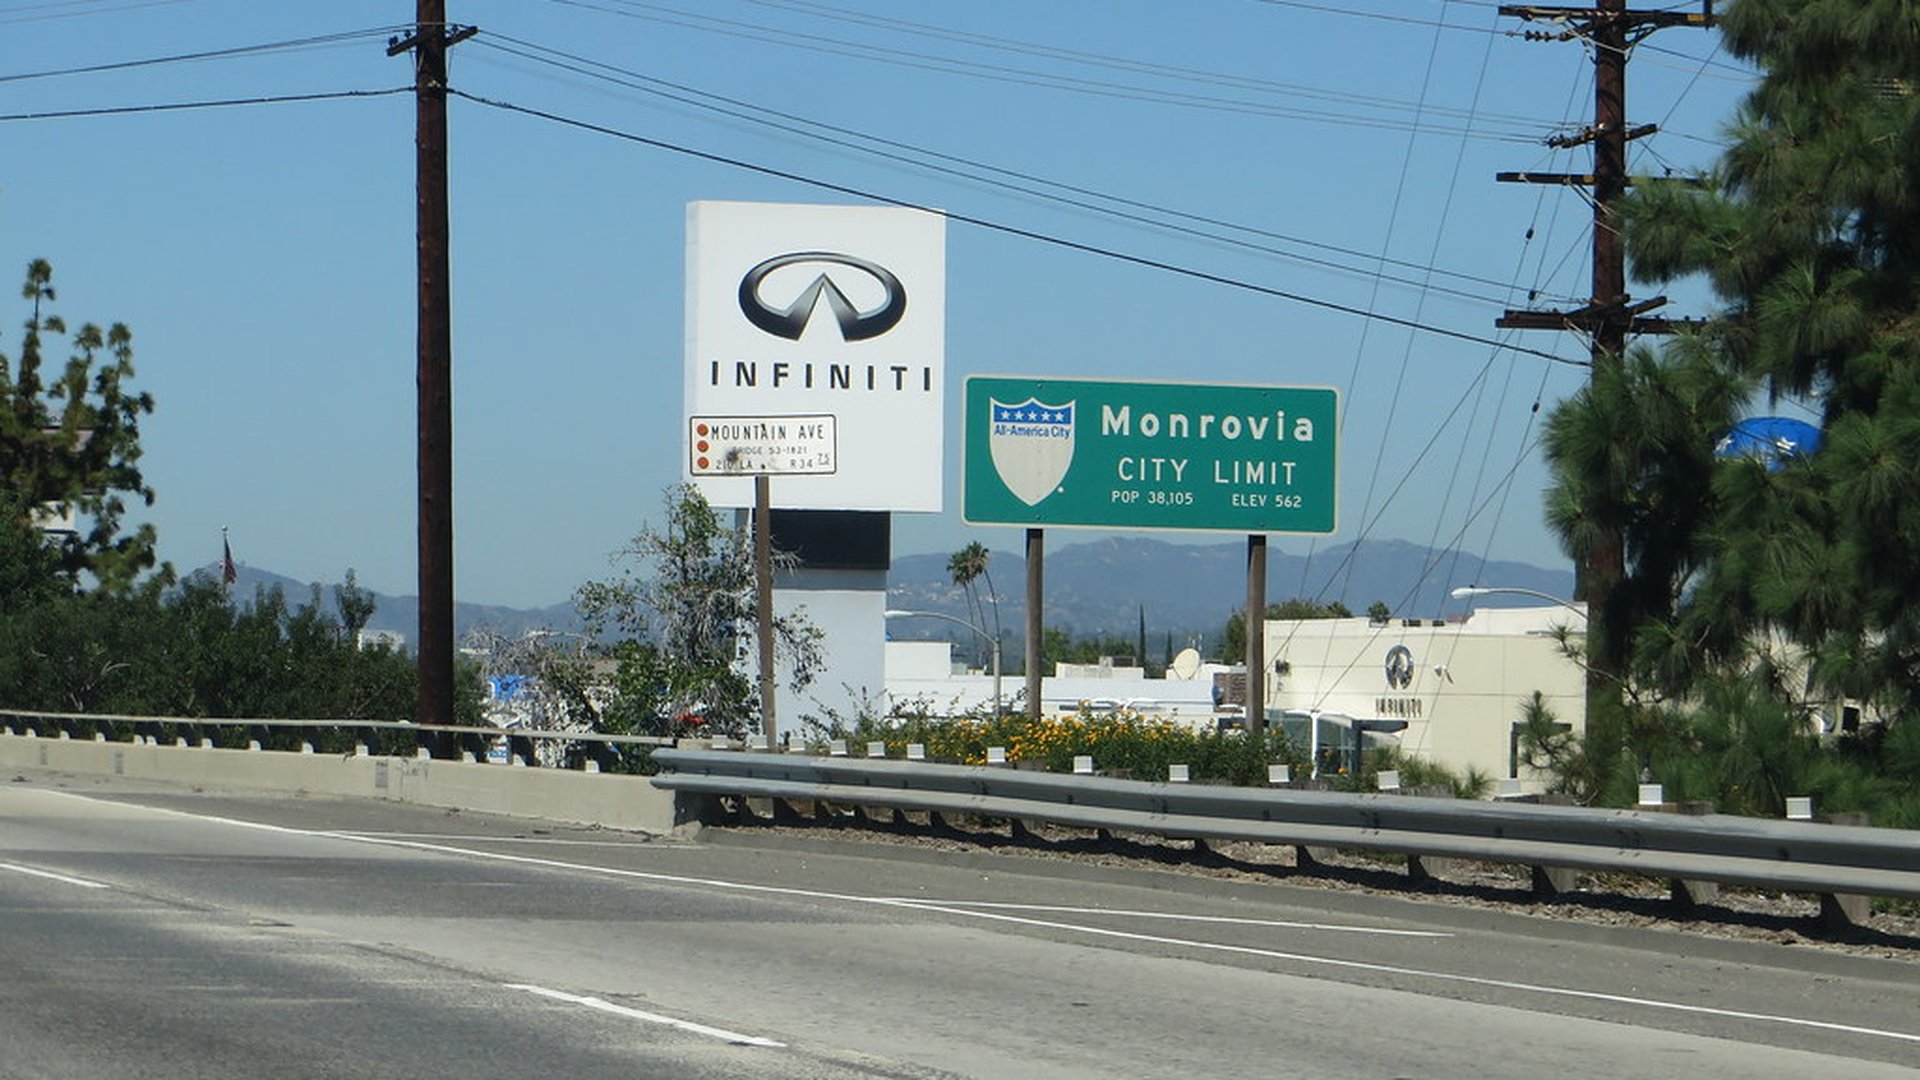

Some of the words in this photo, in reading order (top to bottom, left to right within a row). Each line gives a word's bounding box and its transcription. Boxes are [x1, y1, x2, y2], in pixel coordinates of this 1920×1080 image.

[711, 360, 931, 392] INFINITI
[711, 424, 787, 440] MOUNTAIN
[798, 424, 824, 440] AVE
[994, 424, 1049, 438] All-America
[1051, 426, 1071, 439] City
[1102, 404, 1314, 442] Monrovia
[1118, 457, 1188, 482] CITY
[1214, 460, 1296, 485] LIMIT
[1111, 490, 1139, 504] POP
[1148, 491, 1193, 506] 38,105
[1232, 493, 1267, 508] ELEV
[1275, 494, 1302, 508] 562
